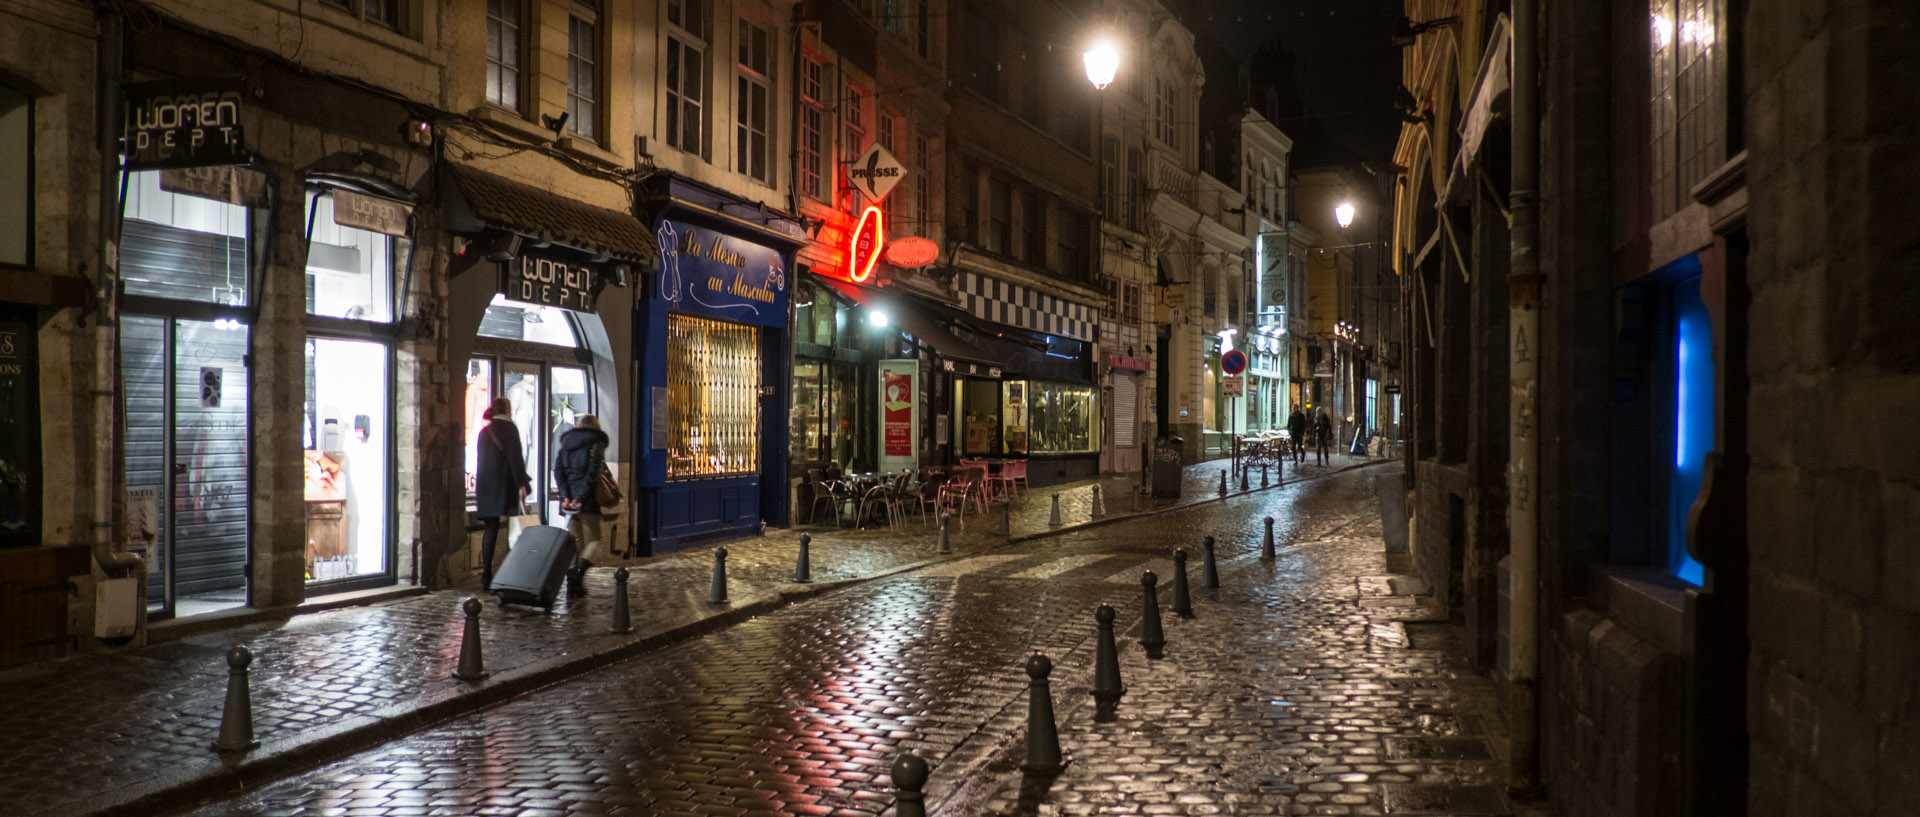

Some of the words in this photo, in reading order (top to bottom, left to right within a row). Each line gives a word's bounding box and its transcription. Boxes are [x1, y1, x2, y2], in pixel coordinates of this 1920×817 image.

[136, 101, 236, 129] WOMEN
[851, 167, 899, 179] PRESSE
[351, 198, 395, 221] WOMEN
[682, 228, 702, 257] La
[704, 236, 746, 269] Mesure
[522, 255, 590, 291] WOMEN
[707, 276, 723, 293] au
[726, 271, 775, 304] Masculin
[0, 335, 15, 354] S
